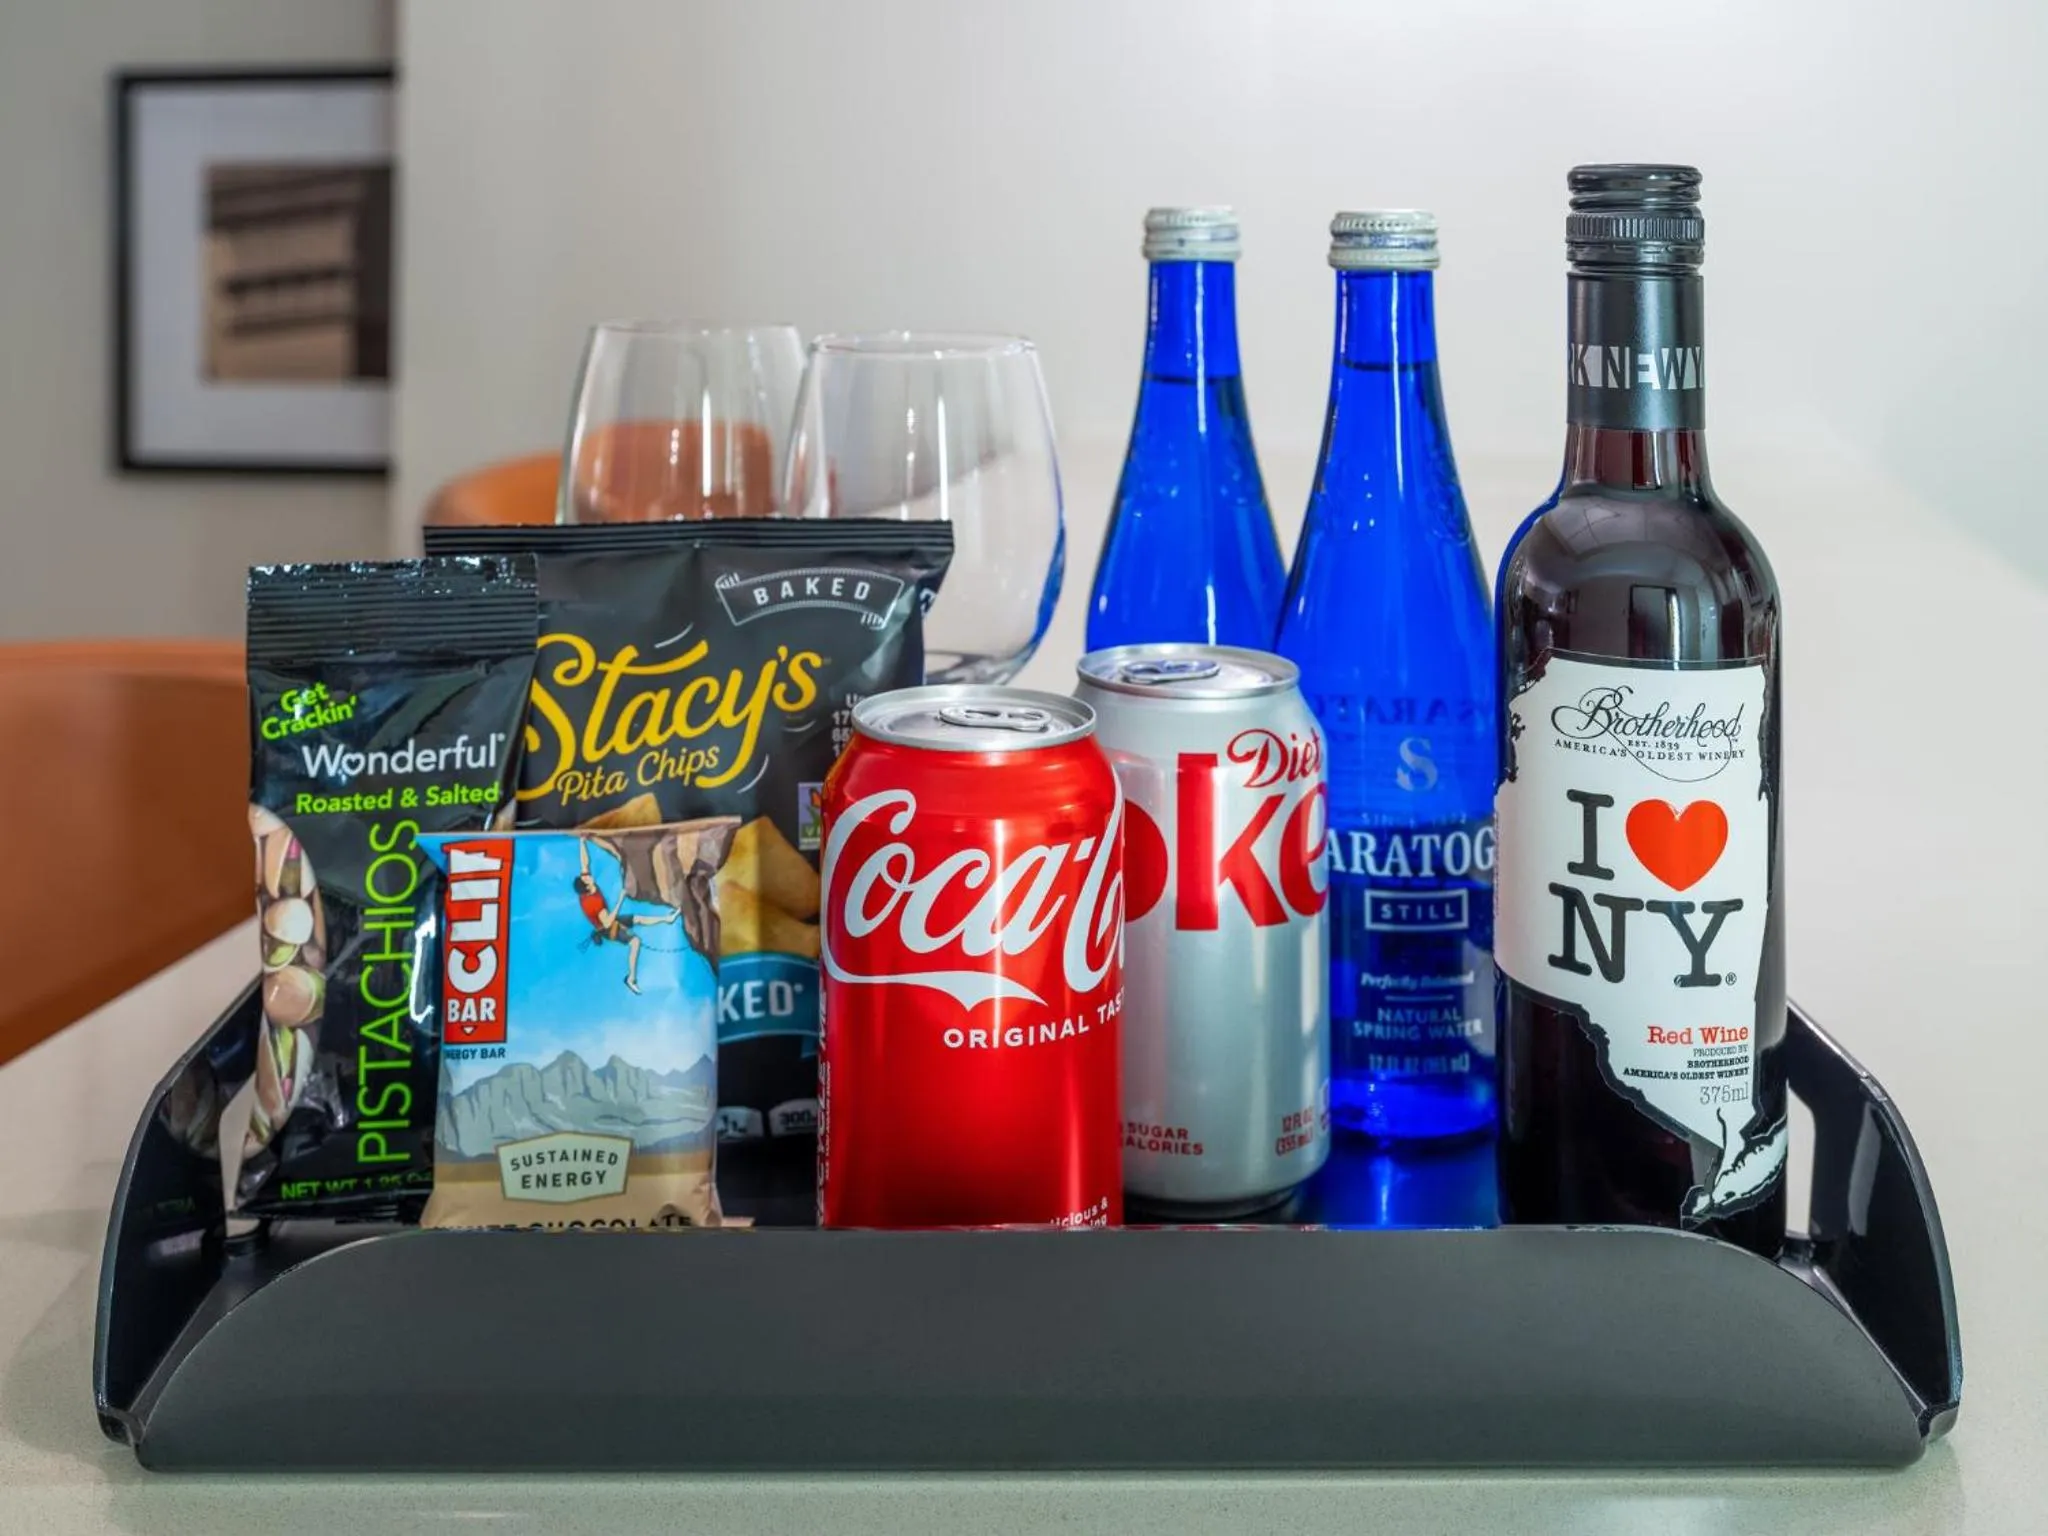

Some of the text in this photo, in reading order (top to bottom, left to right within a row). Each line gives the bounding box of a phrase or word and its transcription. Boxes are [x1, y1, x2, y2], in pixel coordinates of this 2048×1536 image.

[753, 577, 871, 605] BAKED
[280, 681, 330, 712] Get
[261, 695, 357, 741] Crackin'
[516, 633, 822, 800] Stacy's
[1551, 685, 1744, 750] Brotherhood
[302, 733, 498, 779] Wonderful
[1227, 727, 1321, 788] Diet
[1554, 739, 1746, 761] AMERICA'S OLDEST WINERY
[1628, 739, 1651, 749] EST.
[557, 745, 720, 807] Pita Chips
[1396, 737, 1438, 792] S
[296, 782, 500, 814] Roasted & Salted
[1566, 788, 1615, 881] I
[1325, 826, 1495, 878] ARATOG
[1381, 903, 1455, 920] STILL
[1547, 882, 1745, 988] NY
[357, 819, 422, 1163] PISTACHIOS
[717, 979, 794, 1024] KED
[447, 997, 497, 1023] BAR
[1377, 1007, 1461, 1024] NATURAL
[943, 1015, 1090, 1049] ORIGINAL
[1353, 1018, 1483, 1040] SPRING WATER
[1647, 1025, 1749, 1045] Red Wine
[480, 1047, 507, 1059] BAR
[1687, 1055, 1749, 1069] BROTHERHOOD
[1623, 1067, 1679, 1080] AMERICA'S
[1680, 1071, 1715, 1080] OLDEST
[1127, 1122, 1188, 1140] SUGAR
[1126, 1135, 1204, 1156] ALORIES
[510, 1149, 618, 1171] SUSTAINED
[281, 1181, 321, 1199] NET
[325, 1178, 358, 1192] WT
[521, 1170, 607, 1189] ENERGY
